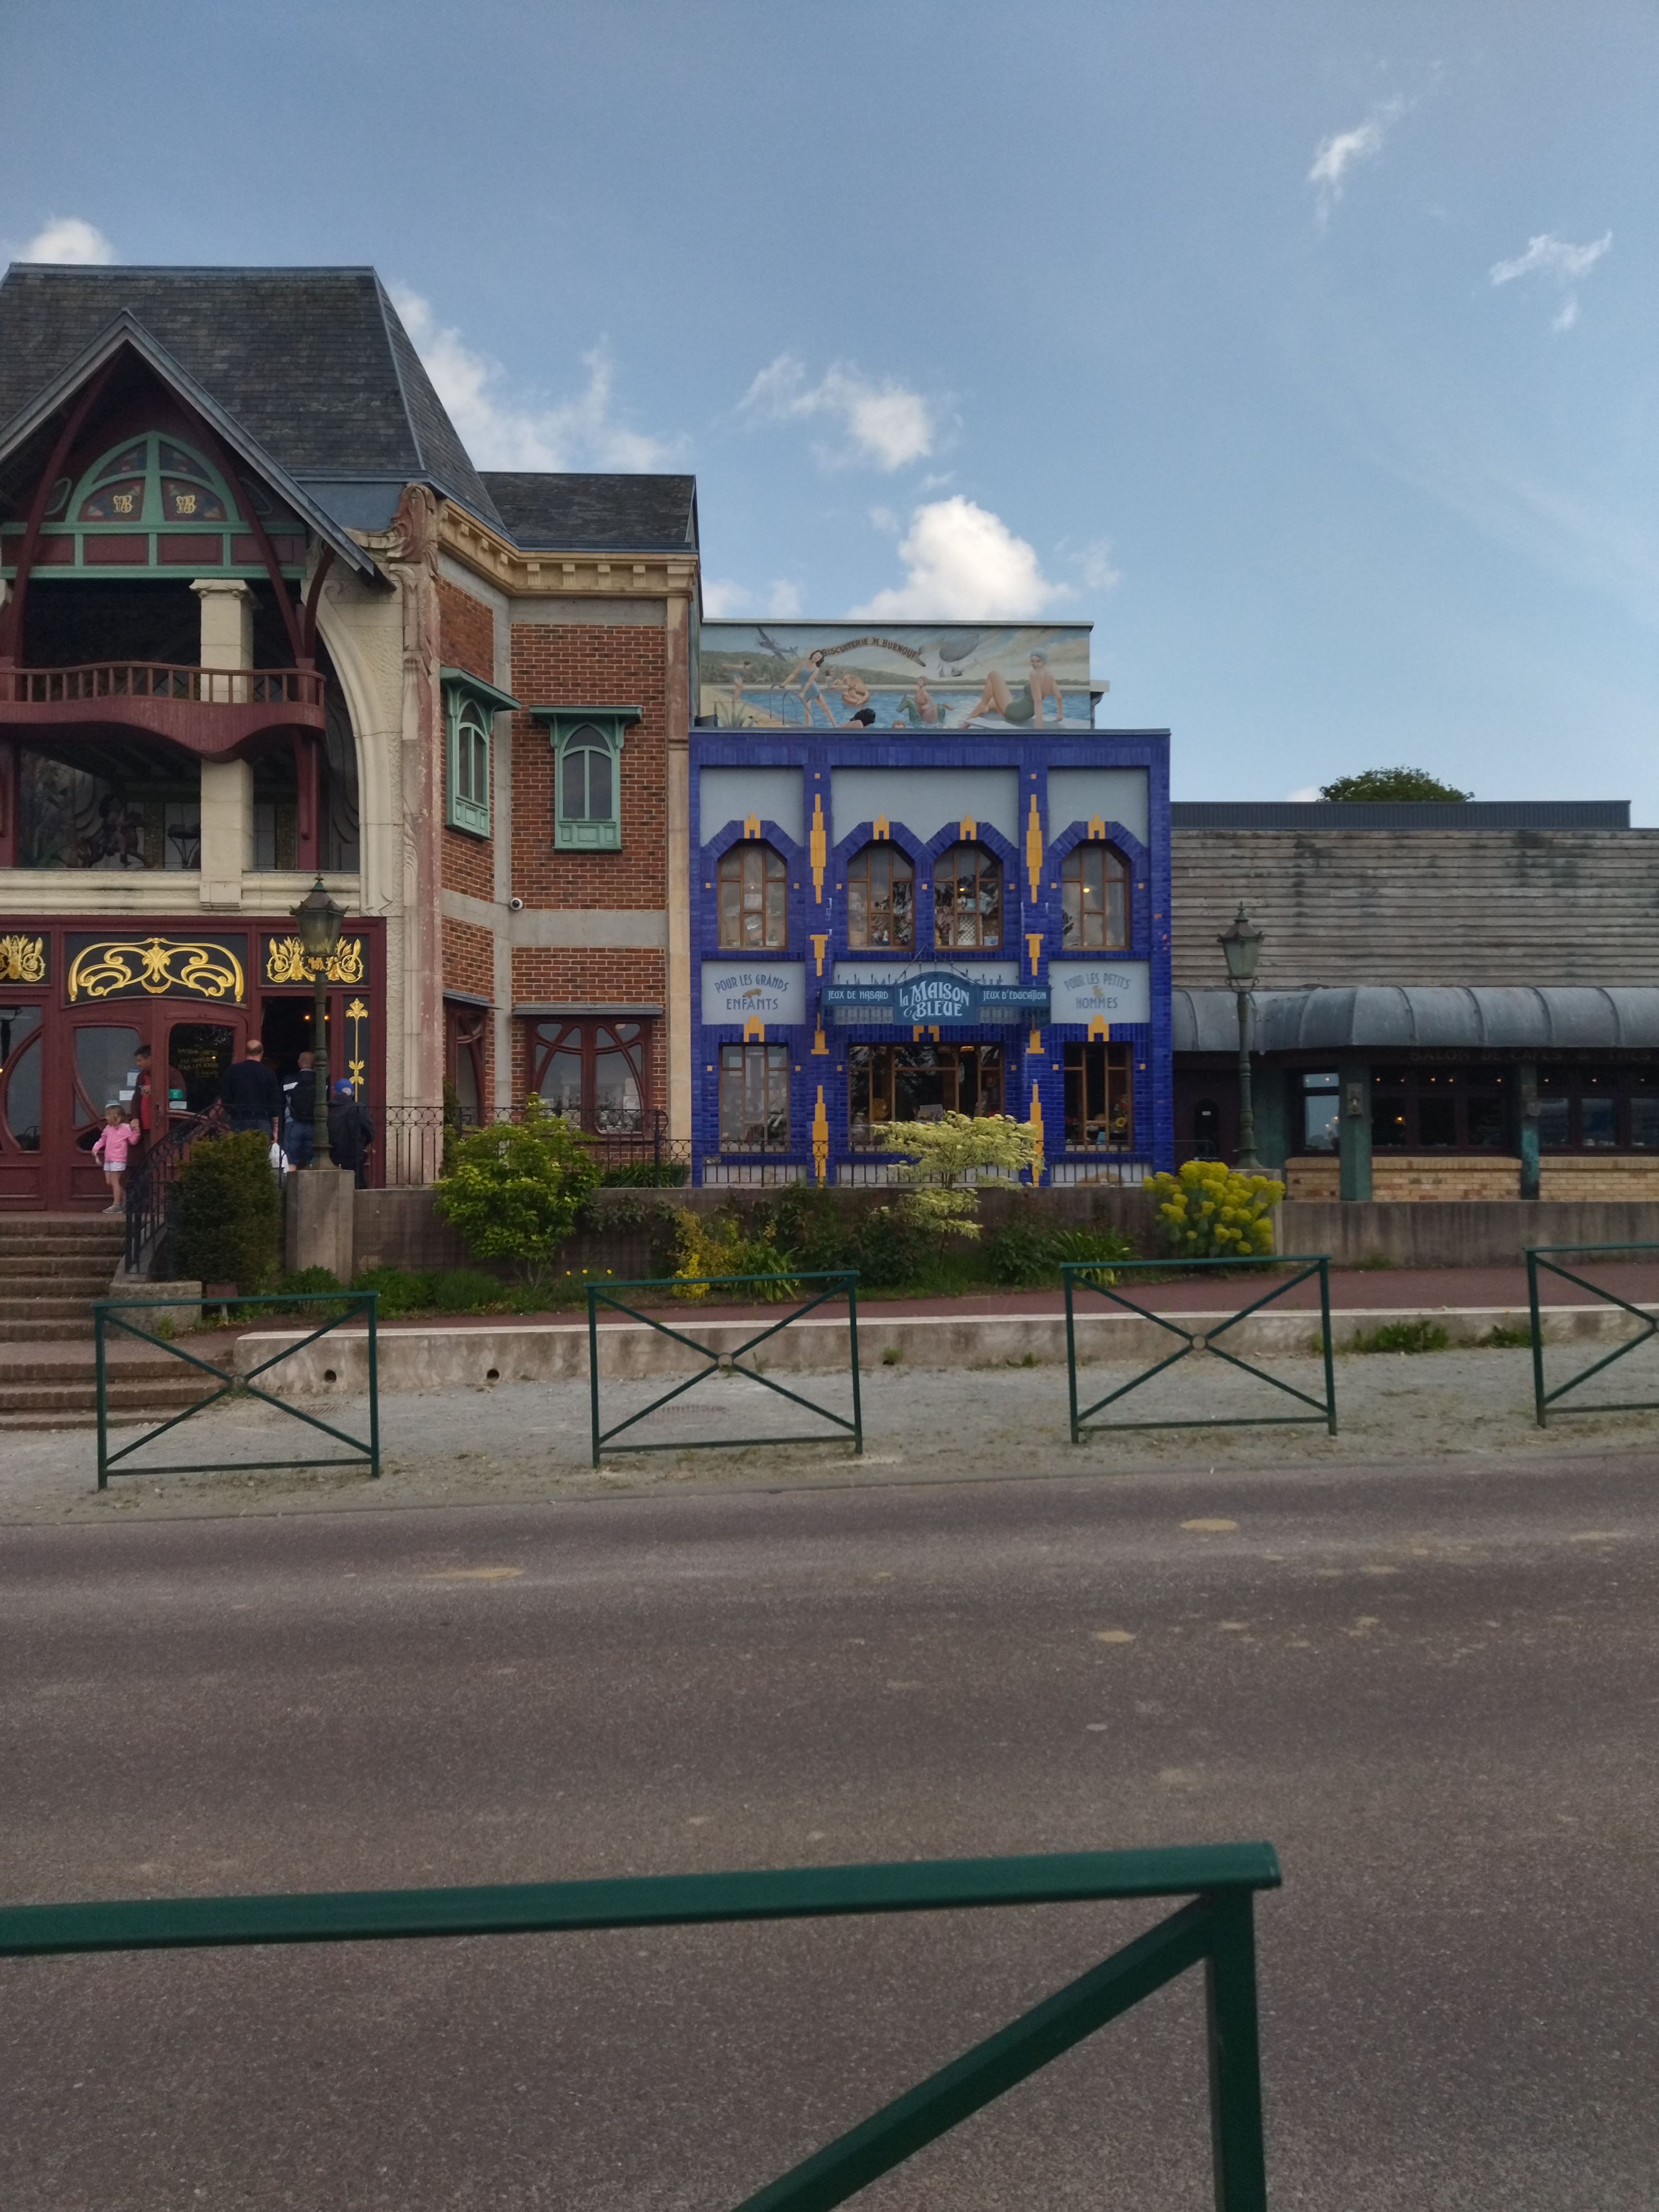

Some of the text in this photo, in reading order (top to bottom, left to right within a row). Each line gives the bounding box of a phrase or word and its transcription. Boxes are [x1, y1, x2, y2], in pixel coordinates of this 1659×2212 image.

[821, 638, 869, 657] BISCUITERIE
[883, 639, 917, 660] BURNOUF
[714, 974, 790, 994] POUR LES GRANDS
[1063, 973, 1131, 991] POUR LES PETITS
[828, 990, 889, 1001] JEUX DE HASARD
[904, 980, 969, 1016] MAISON
[983, 990, 1000, 1001] JEUX
[1076, 997, 1118, 1009] HOMMES
[726, 998, 779, 1010] ENFANTS
[912, 1000, 963, 1021] BLEUE
[1408, 1050, 1471, 1061] SALON
